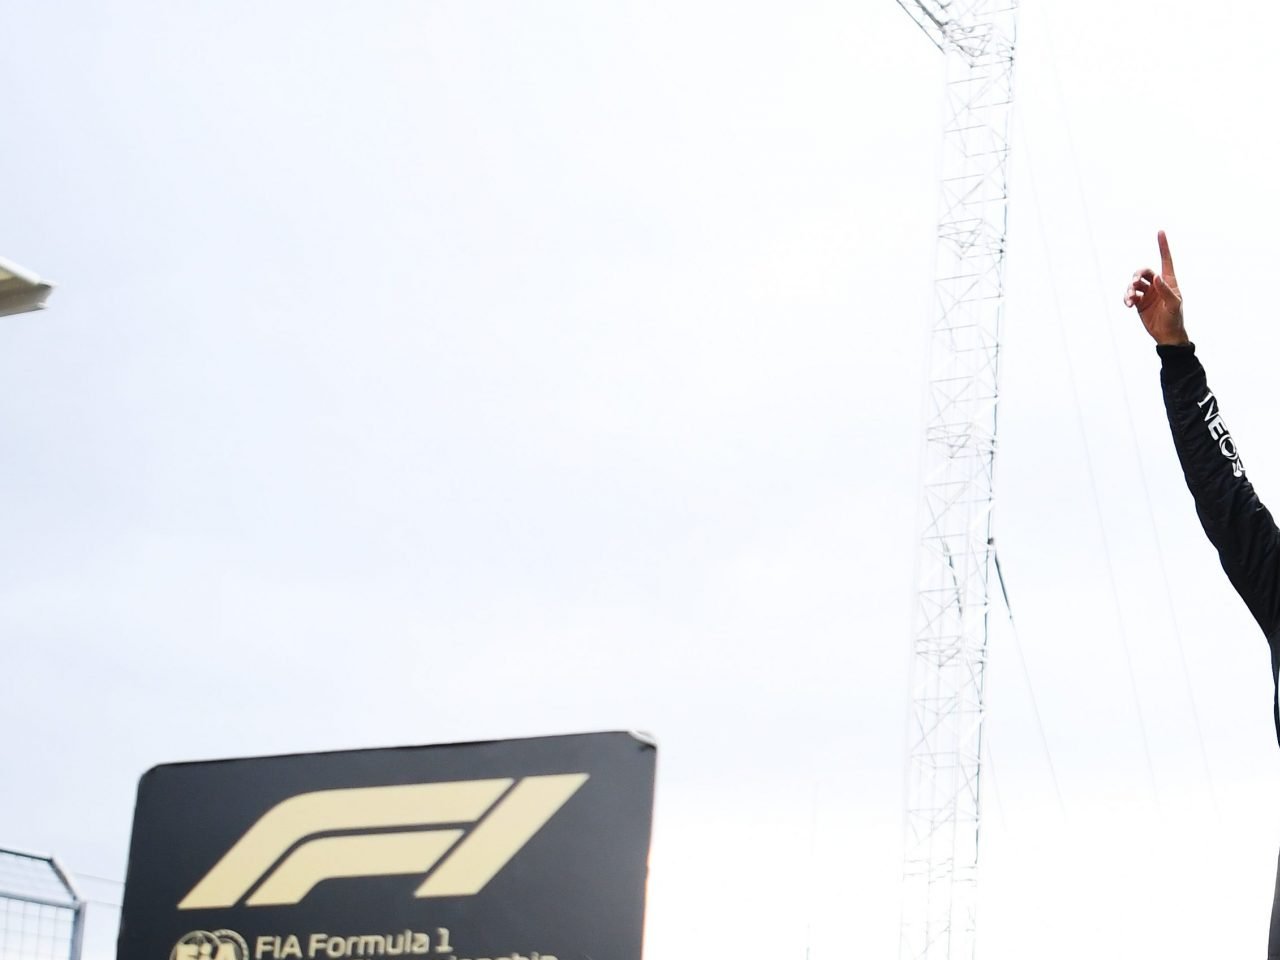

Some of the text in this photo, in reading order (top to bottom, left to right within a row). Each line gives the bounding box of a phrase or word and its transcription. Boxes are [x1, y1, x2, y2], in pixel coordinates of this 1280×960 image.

[255, 927, 453, 960] FIA Formula 1
